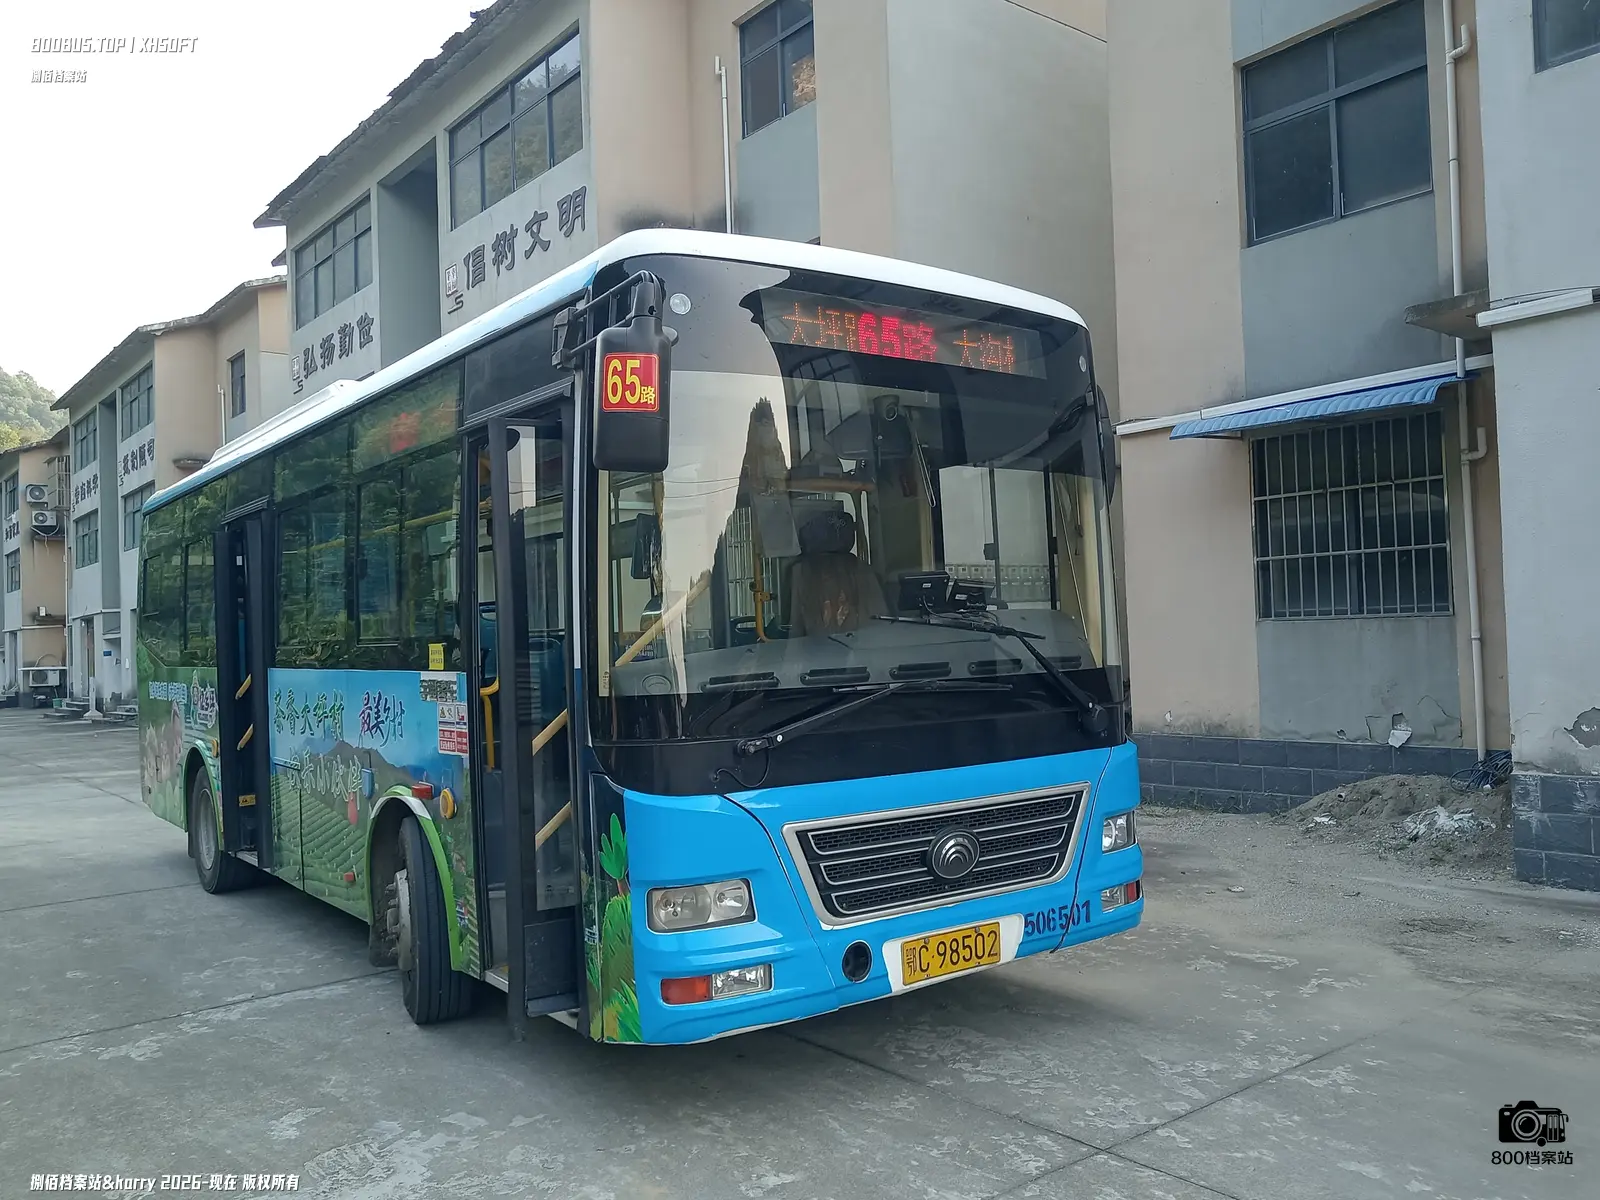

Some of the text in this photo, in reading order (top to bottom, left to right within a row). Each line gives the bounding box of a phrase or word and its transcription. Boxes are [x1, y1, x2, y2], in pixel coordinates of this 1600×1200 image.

[463, 185, 587, 291] 倡树文明
[303, 312, 375, 379] 弘扬勤俭
[607, 358, 656, 405] 65路
[1024, 899, 1092, 938] 506501
